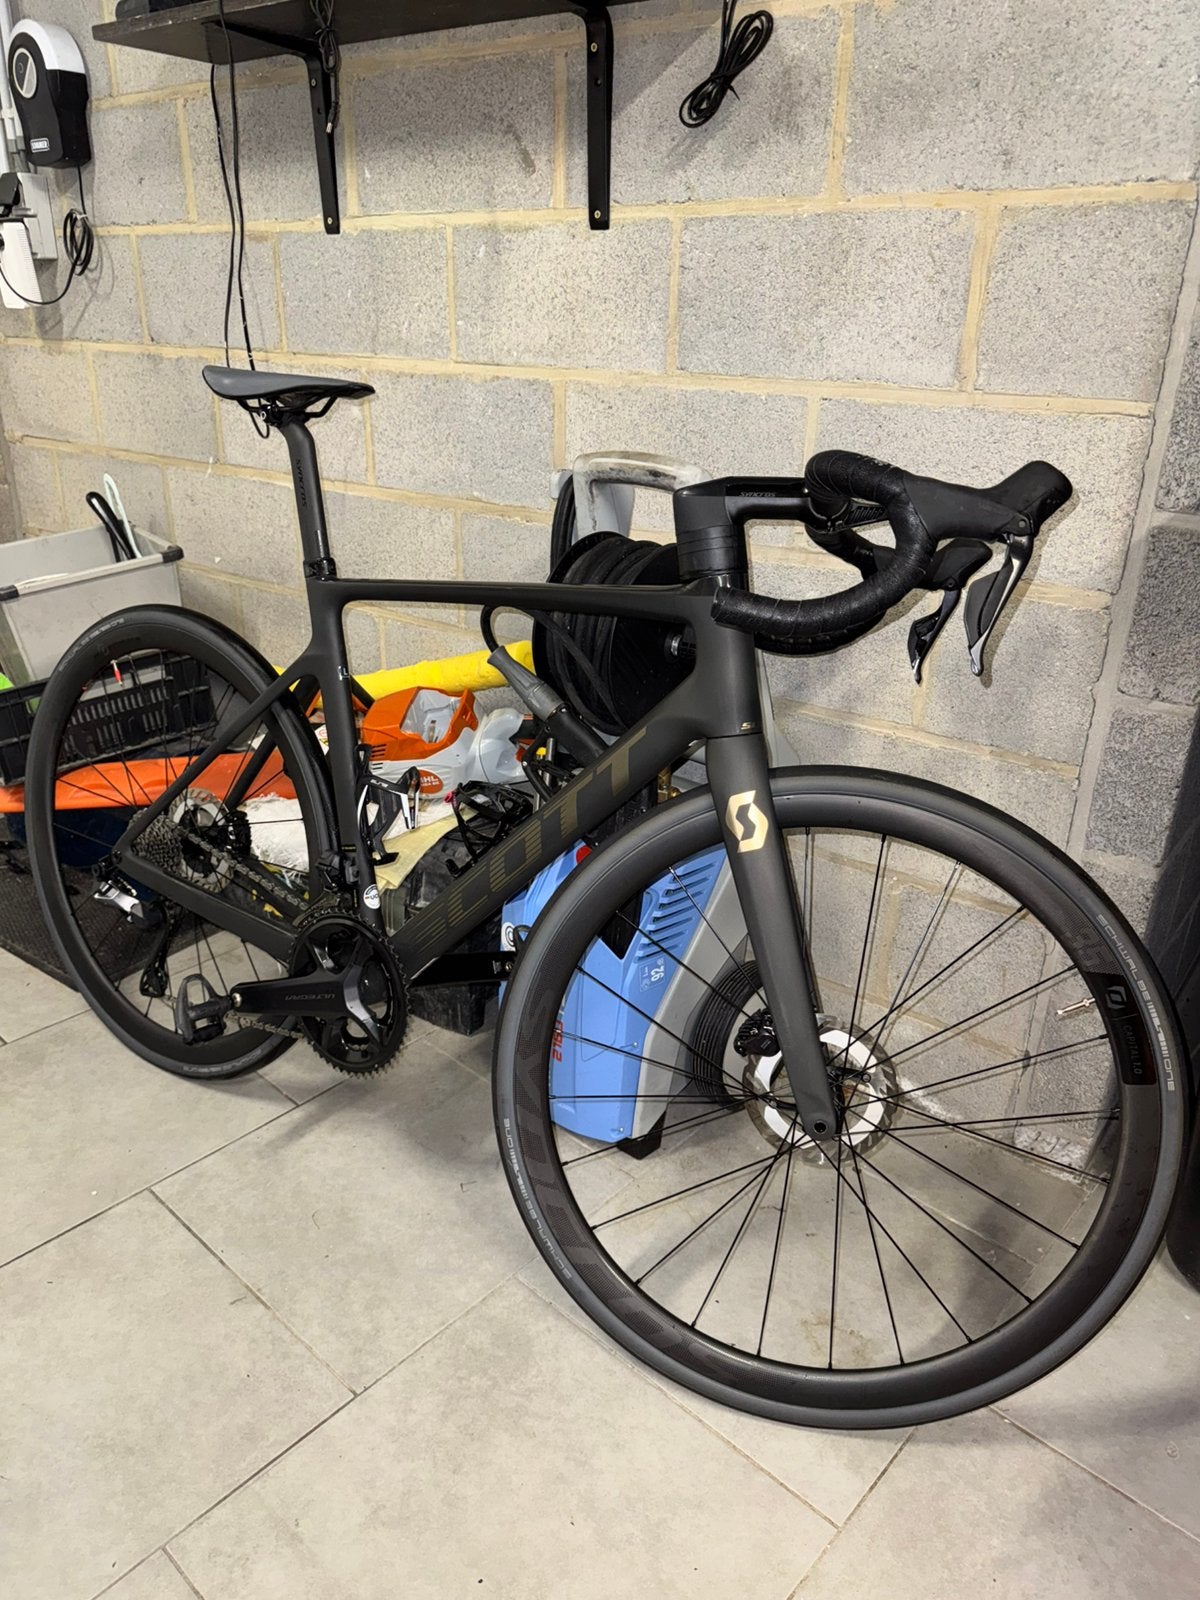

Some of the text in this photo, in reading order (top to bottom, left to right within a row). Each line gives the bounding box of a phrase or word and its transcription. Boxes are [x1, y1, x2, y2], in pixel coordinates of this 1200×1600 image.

[404, 727, 647, 954] SCOTT
[650, 965, 665, 981] 92
[1096, 913, 1175, 1092] SCHWALBE ONE
[525, 1199, 573, 1280] SCHWALBE
